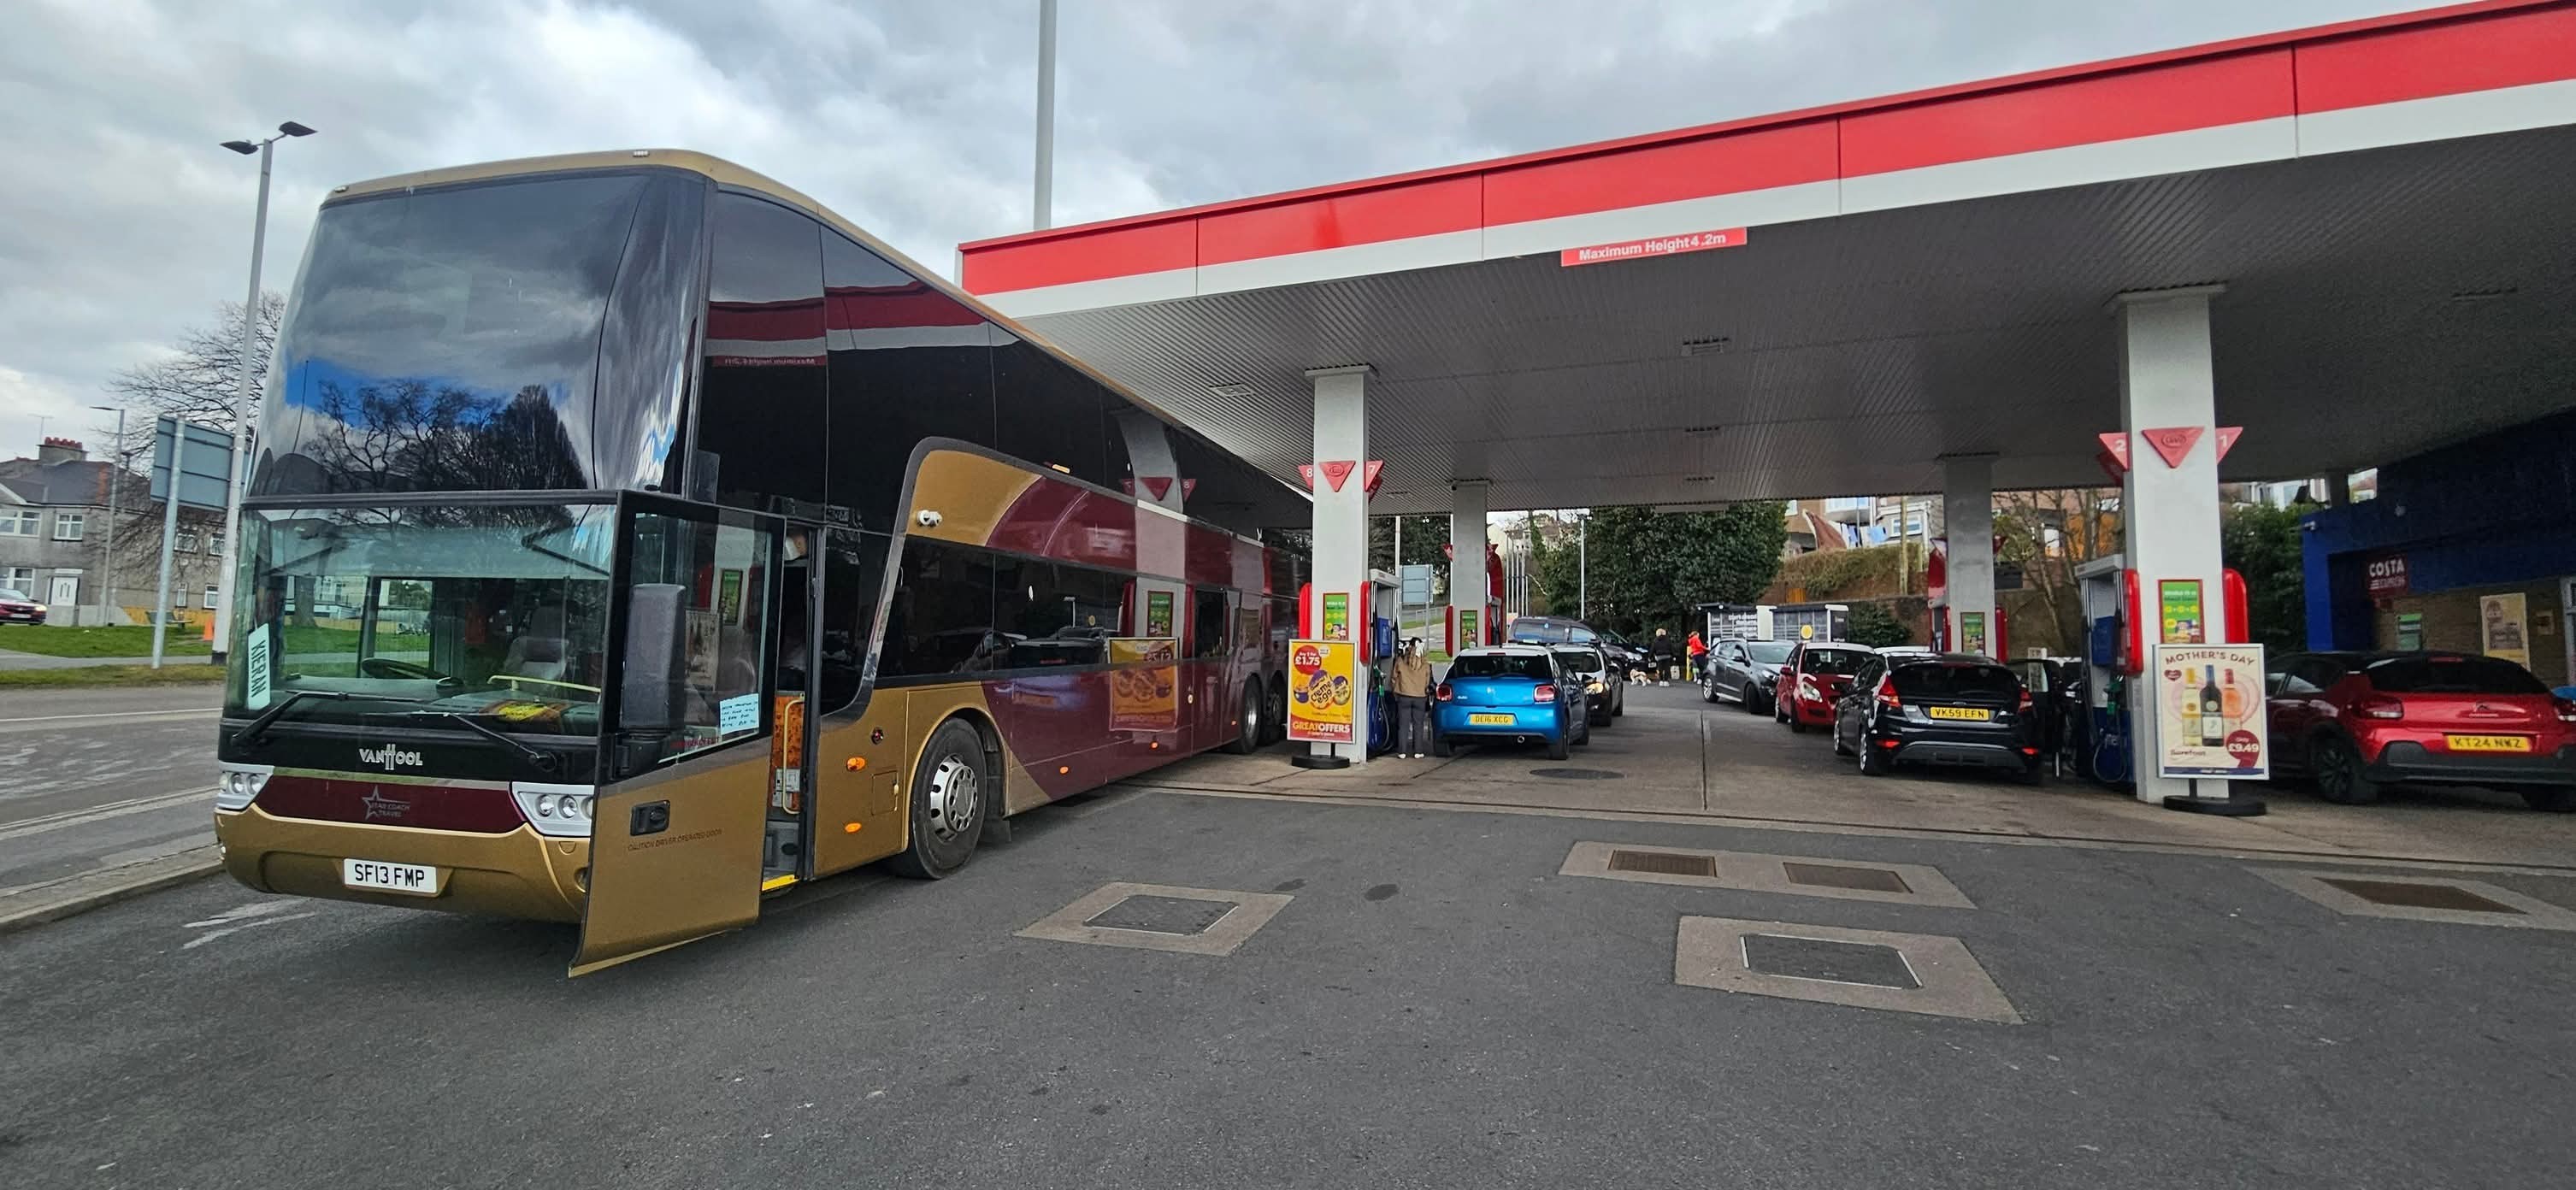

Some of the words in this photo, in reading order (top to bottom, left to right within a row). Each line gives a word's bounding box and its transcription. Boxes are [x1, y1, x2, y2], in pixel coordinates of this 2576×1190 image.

[1579, 244, 1642, 261] Maximum
[1645, 239, 1689, 253] Height
[2114, 439, 2125, 452] 2
[2219, 434, 2228, 447] 1
[1306, 468, 1313, 478] 8
[1369, 464, 1376, 474] 7
[2369, 558, 2405, 577] COSTA
[1295, 656, 1320, 665] £1.75
[2166, 651, 2226, 664] MOTHER'S
[2231, 653, 2255, 666] DAY
[251, 639, 267, 698] KIERAN
[1935, 709, 1961, 717] VK59
[1965, 710, 1984, 719] EFN
[2229, 744, 2259, 752] £9.49
[2455, 738, 2491, 746] KT24
[355, 863, 389, 884] SF13
[394, 867, 425, 887] FMP
